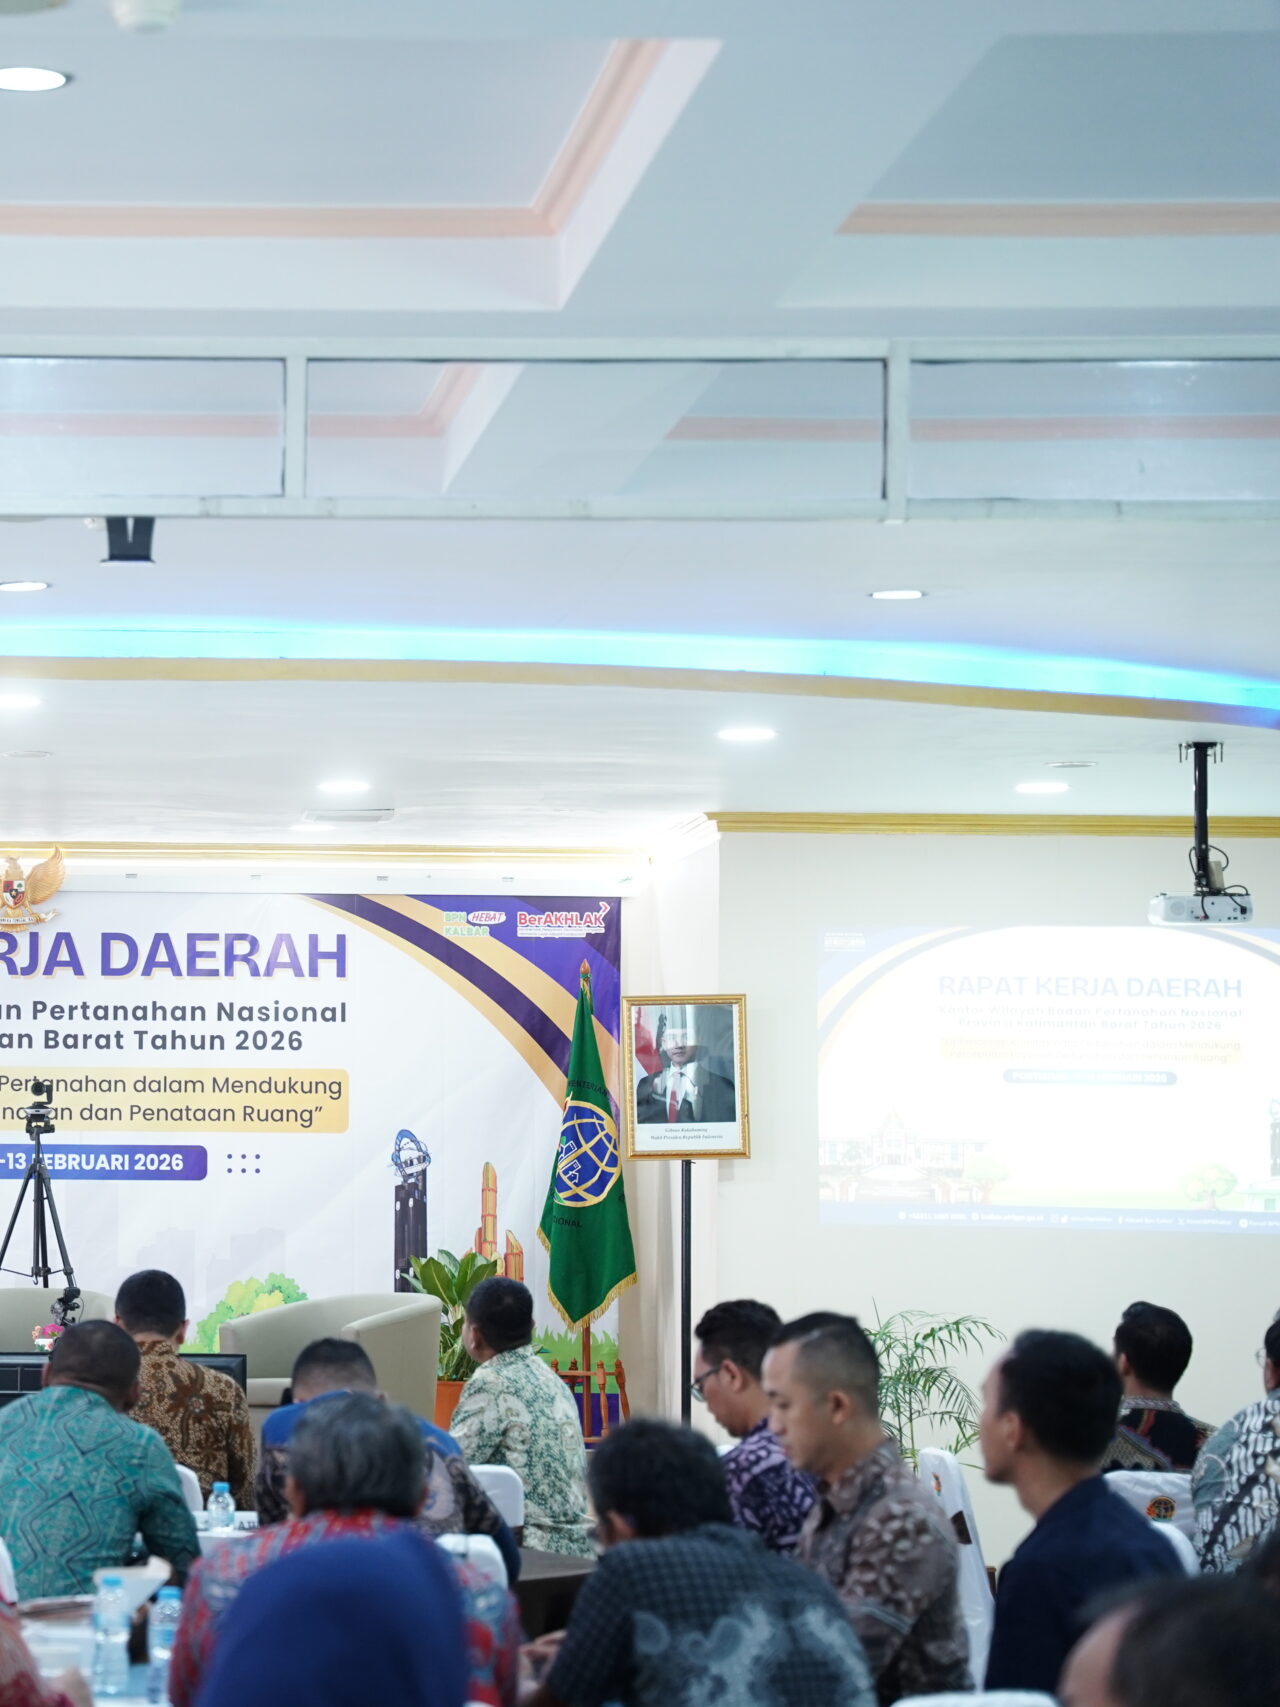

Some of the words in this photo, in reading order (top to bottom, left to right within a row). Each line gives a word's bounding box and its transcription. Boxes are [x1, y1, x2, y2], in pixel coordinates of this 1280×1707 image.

[444, 911, 467, 923] BPN
[471, 912, 505, 922] HEBAT
[518, 912, 604, 926] BerAKHLAK
[445, 926, 490, 936] KALBAR
[101, 932, 347, 977] DAERAH
[938, 976, 1028, 997] RAPAT
[1036, 977, 1119, 997] KERJA
[1126, 978, 1243, 998] DAERAH
[33, 1001, 206, 1021] Pertanahan
[218, 1001, 346, 1022] Nasional
[1181, 1008, 1243, 1018] Nasional
[1190, 1021, 1222, 1031] 2026
[45, 1029, 124, 1050] Barat
[134, 1030, 225, 1050] Tahun
[236, 1030, 303, 1051] 2026
[134, 1076, 205, 1093] dalam
[212, 1077, 342, 1100] Mendukung
[80, 1104, 122, 1121] dan
[130, 1104, 236, 1122] Penataan
[32, 1153, 129, 1171] EBRUARI
[134, 1153, 184, 1171] 2026
